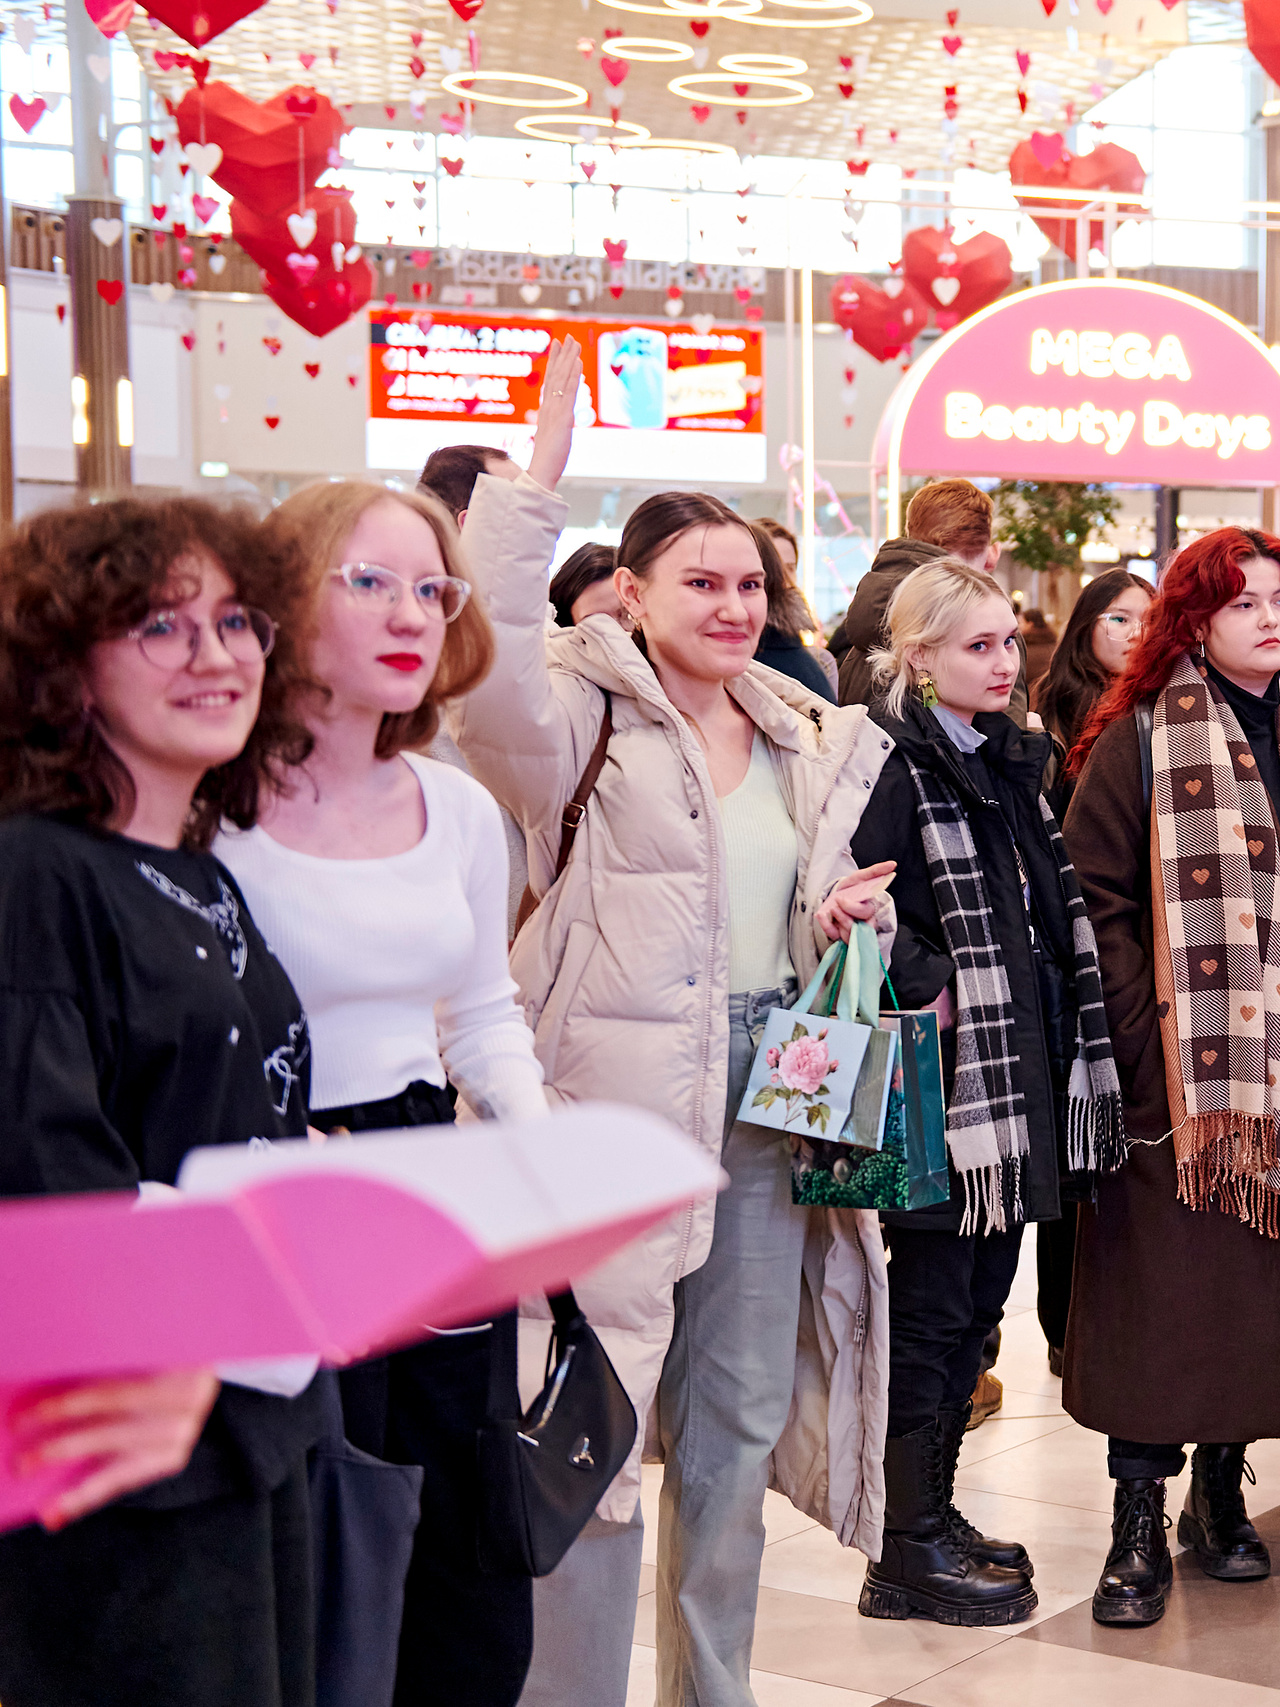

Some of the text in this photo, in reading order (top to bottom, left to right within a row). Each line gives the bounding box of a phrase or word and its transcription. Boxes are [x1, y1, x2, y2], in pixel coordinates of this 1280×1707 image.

[1030, 328, 1192, 381] MEGA
[945, 391, 1136, 455] Beauty
[1143, 400, 1272, 459] Days
